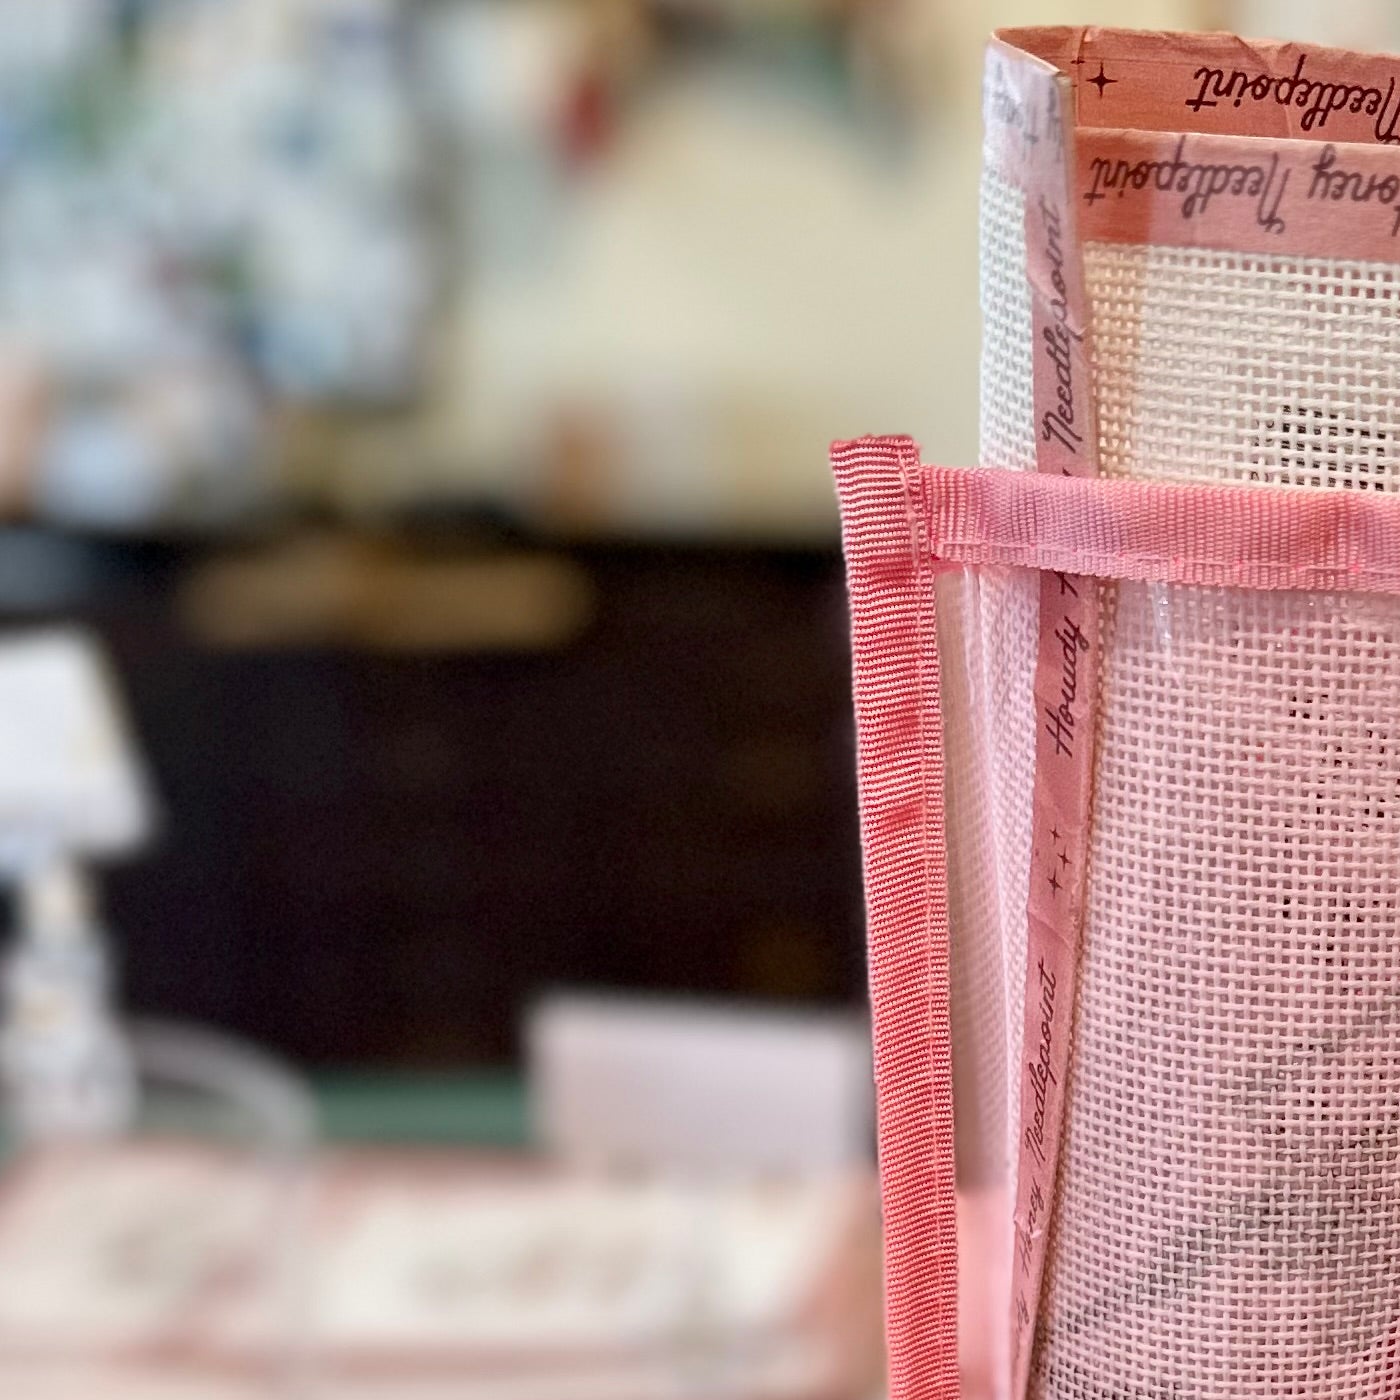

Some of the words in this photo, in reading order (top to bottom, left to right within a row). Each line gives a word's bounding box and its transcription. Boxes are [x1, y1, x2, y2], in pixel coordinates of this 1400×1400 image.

[1083, 135, 1286, 234] Needlepoint
[1040, 193, 1084, 454] Needlepoint
[1045, 614, 1090, 758] Howdy
[1023, 956, 1058, 1168] Needlepoint
